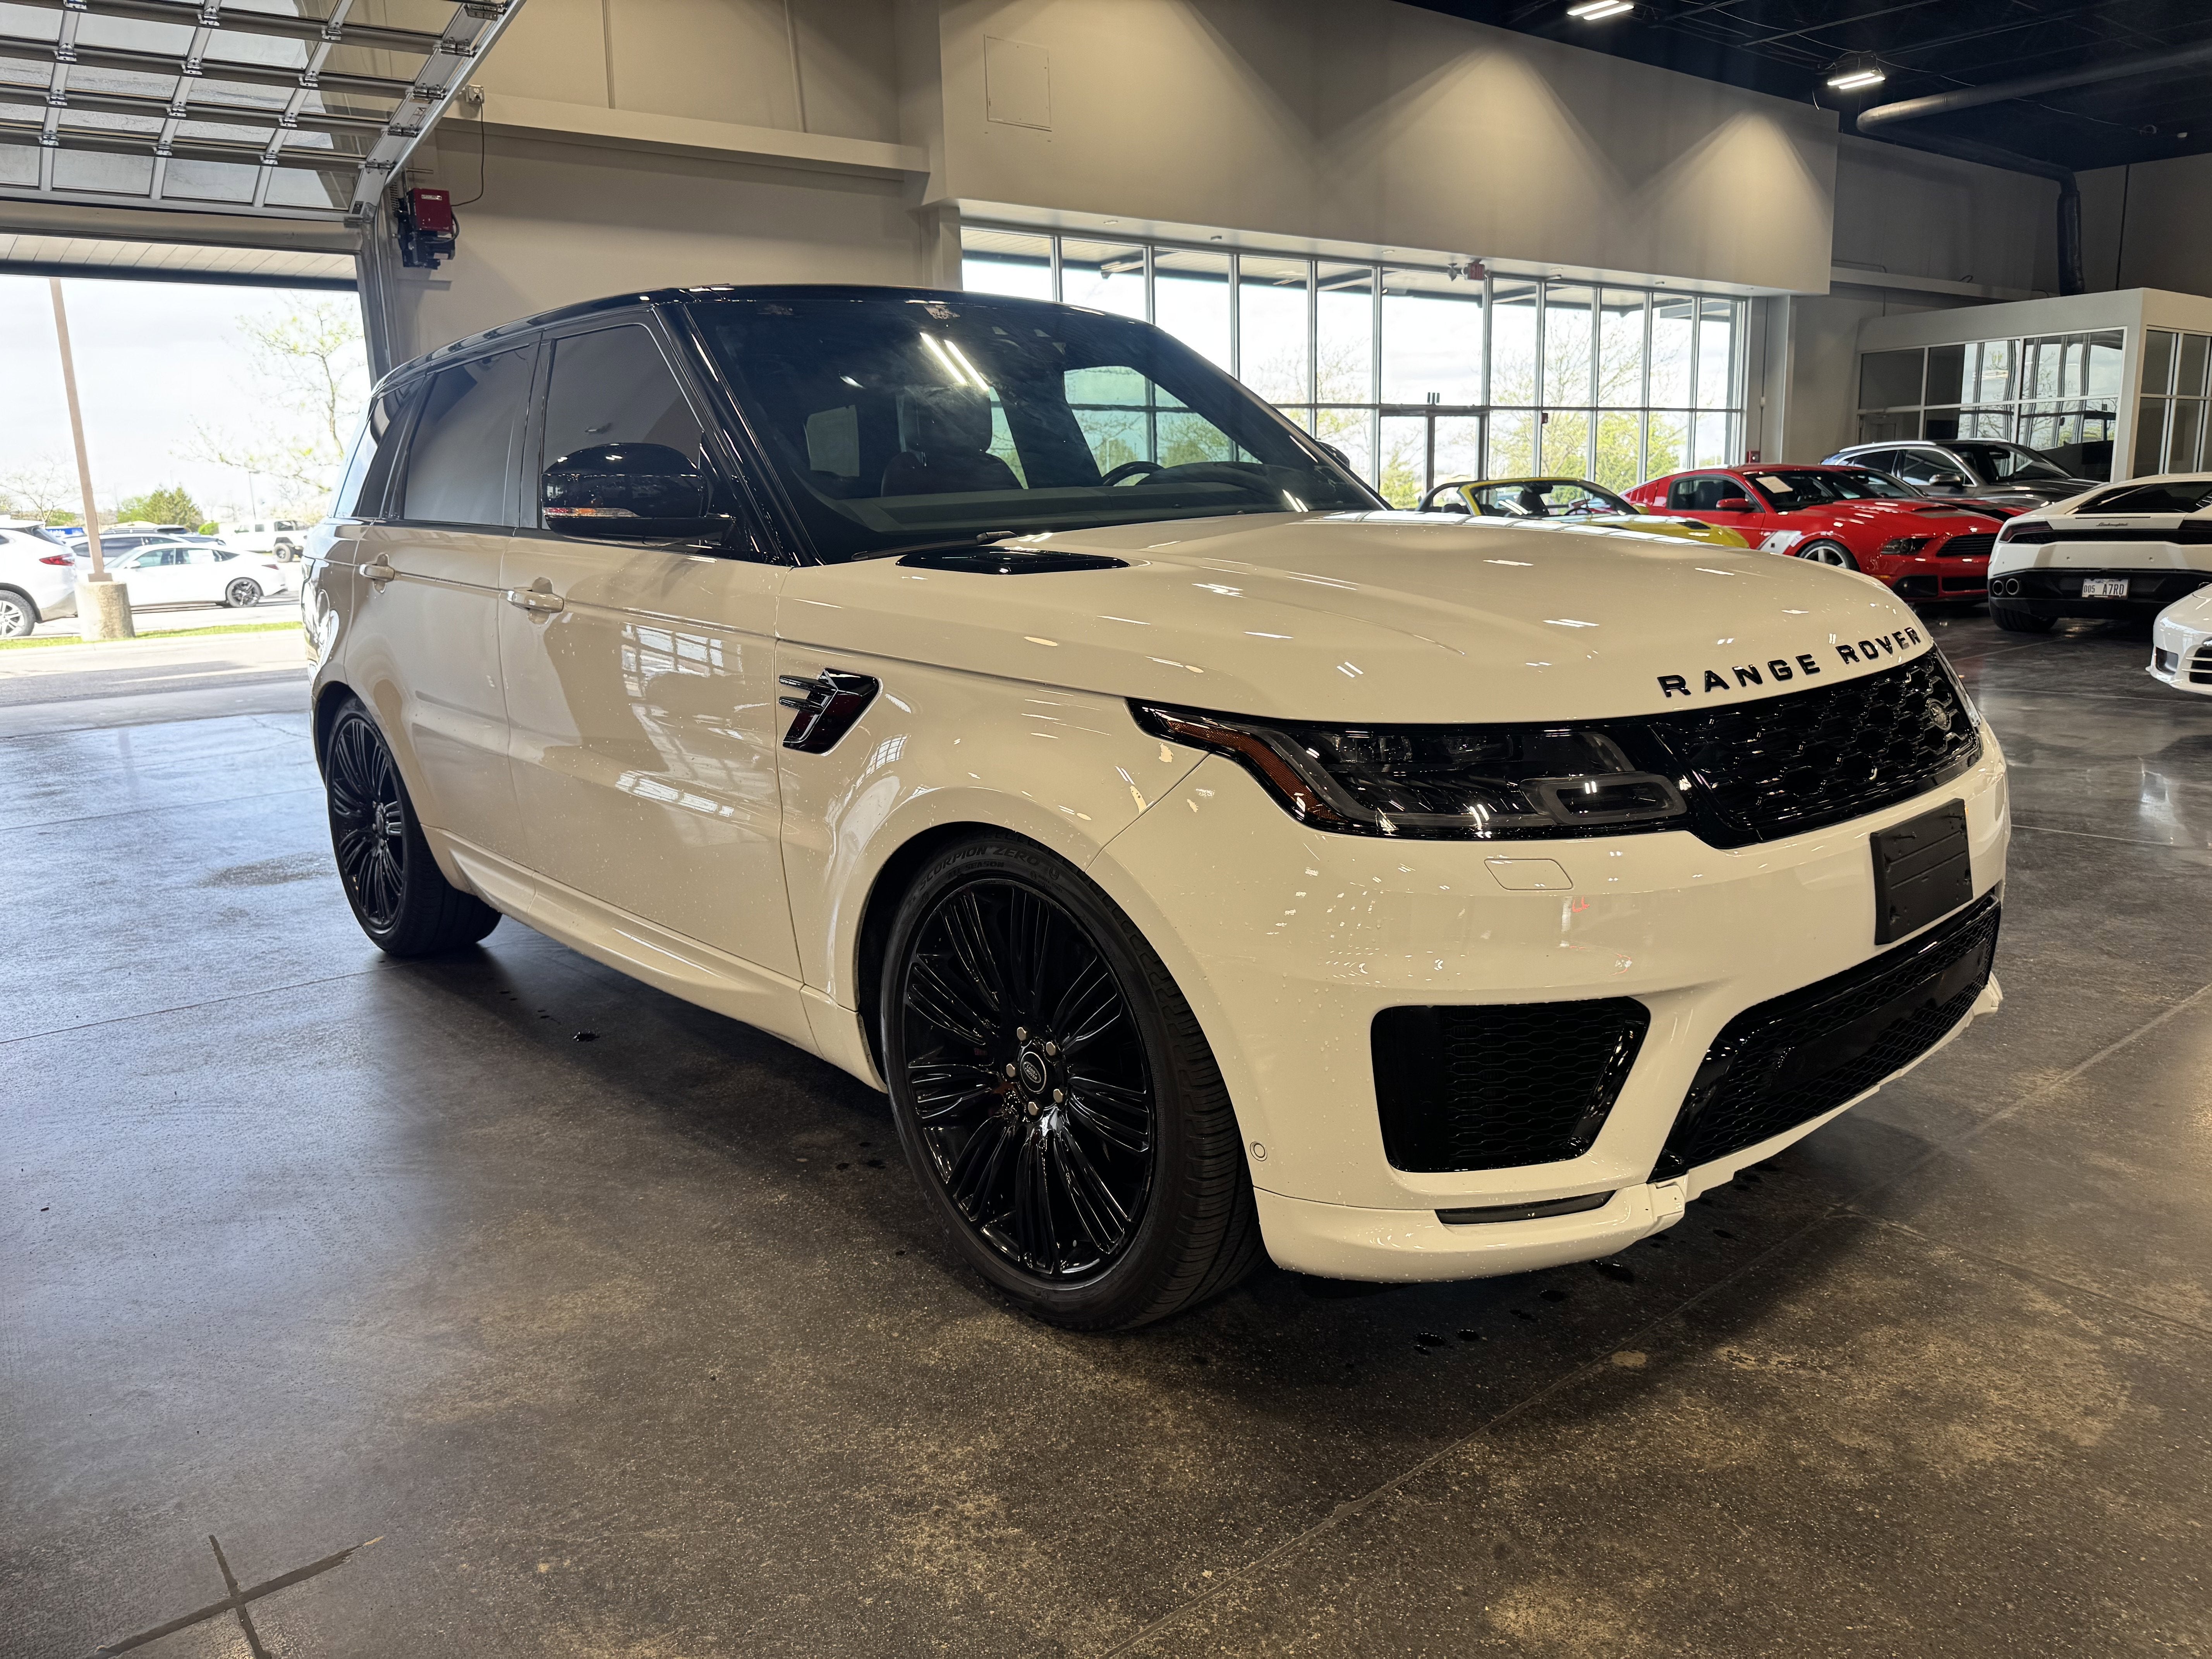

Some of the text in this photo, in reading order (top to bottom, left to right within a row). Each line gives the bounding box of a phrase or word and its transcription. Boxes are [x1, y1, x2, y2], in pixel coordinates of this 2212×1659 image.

[1657, 627, 1922, 697] RANGE ROVER
[919, 845, 1040, 891] SCORPION ZERO
[965, 860, 1005, 870] SEASON
[1026, 1065, 1036, 1074] LAND
[1026, 1068, 1037, 1080] ROVER
